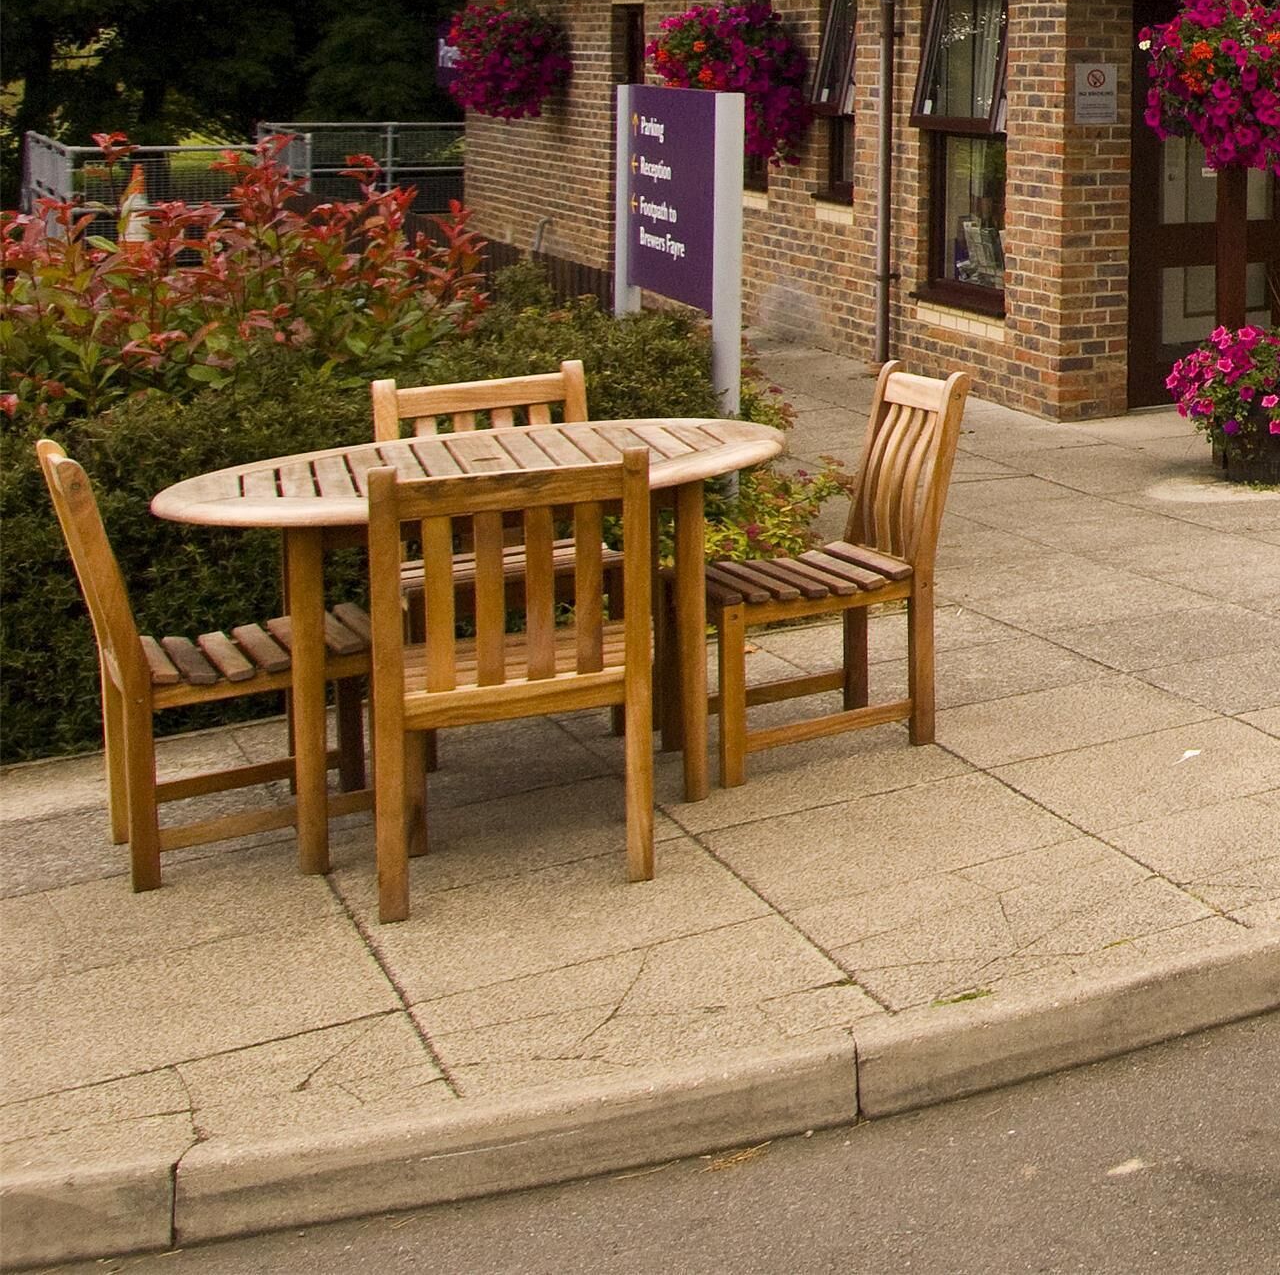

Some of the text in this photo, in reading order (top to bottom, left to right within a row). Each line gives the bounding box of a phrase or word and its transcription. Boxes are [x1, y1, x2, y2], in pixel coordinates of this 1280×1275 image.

[640, 116, 664, 143] Parking
[640, 156, 671, 183] Reception
[640, 195, 677, 223] Footpath to
[640, 226, 685, 261] Brewers Fayre
